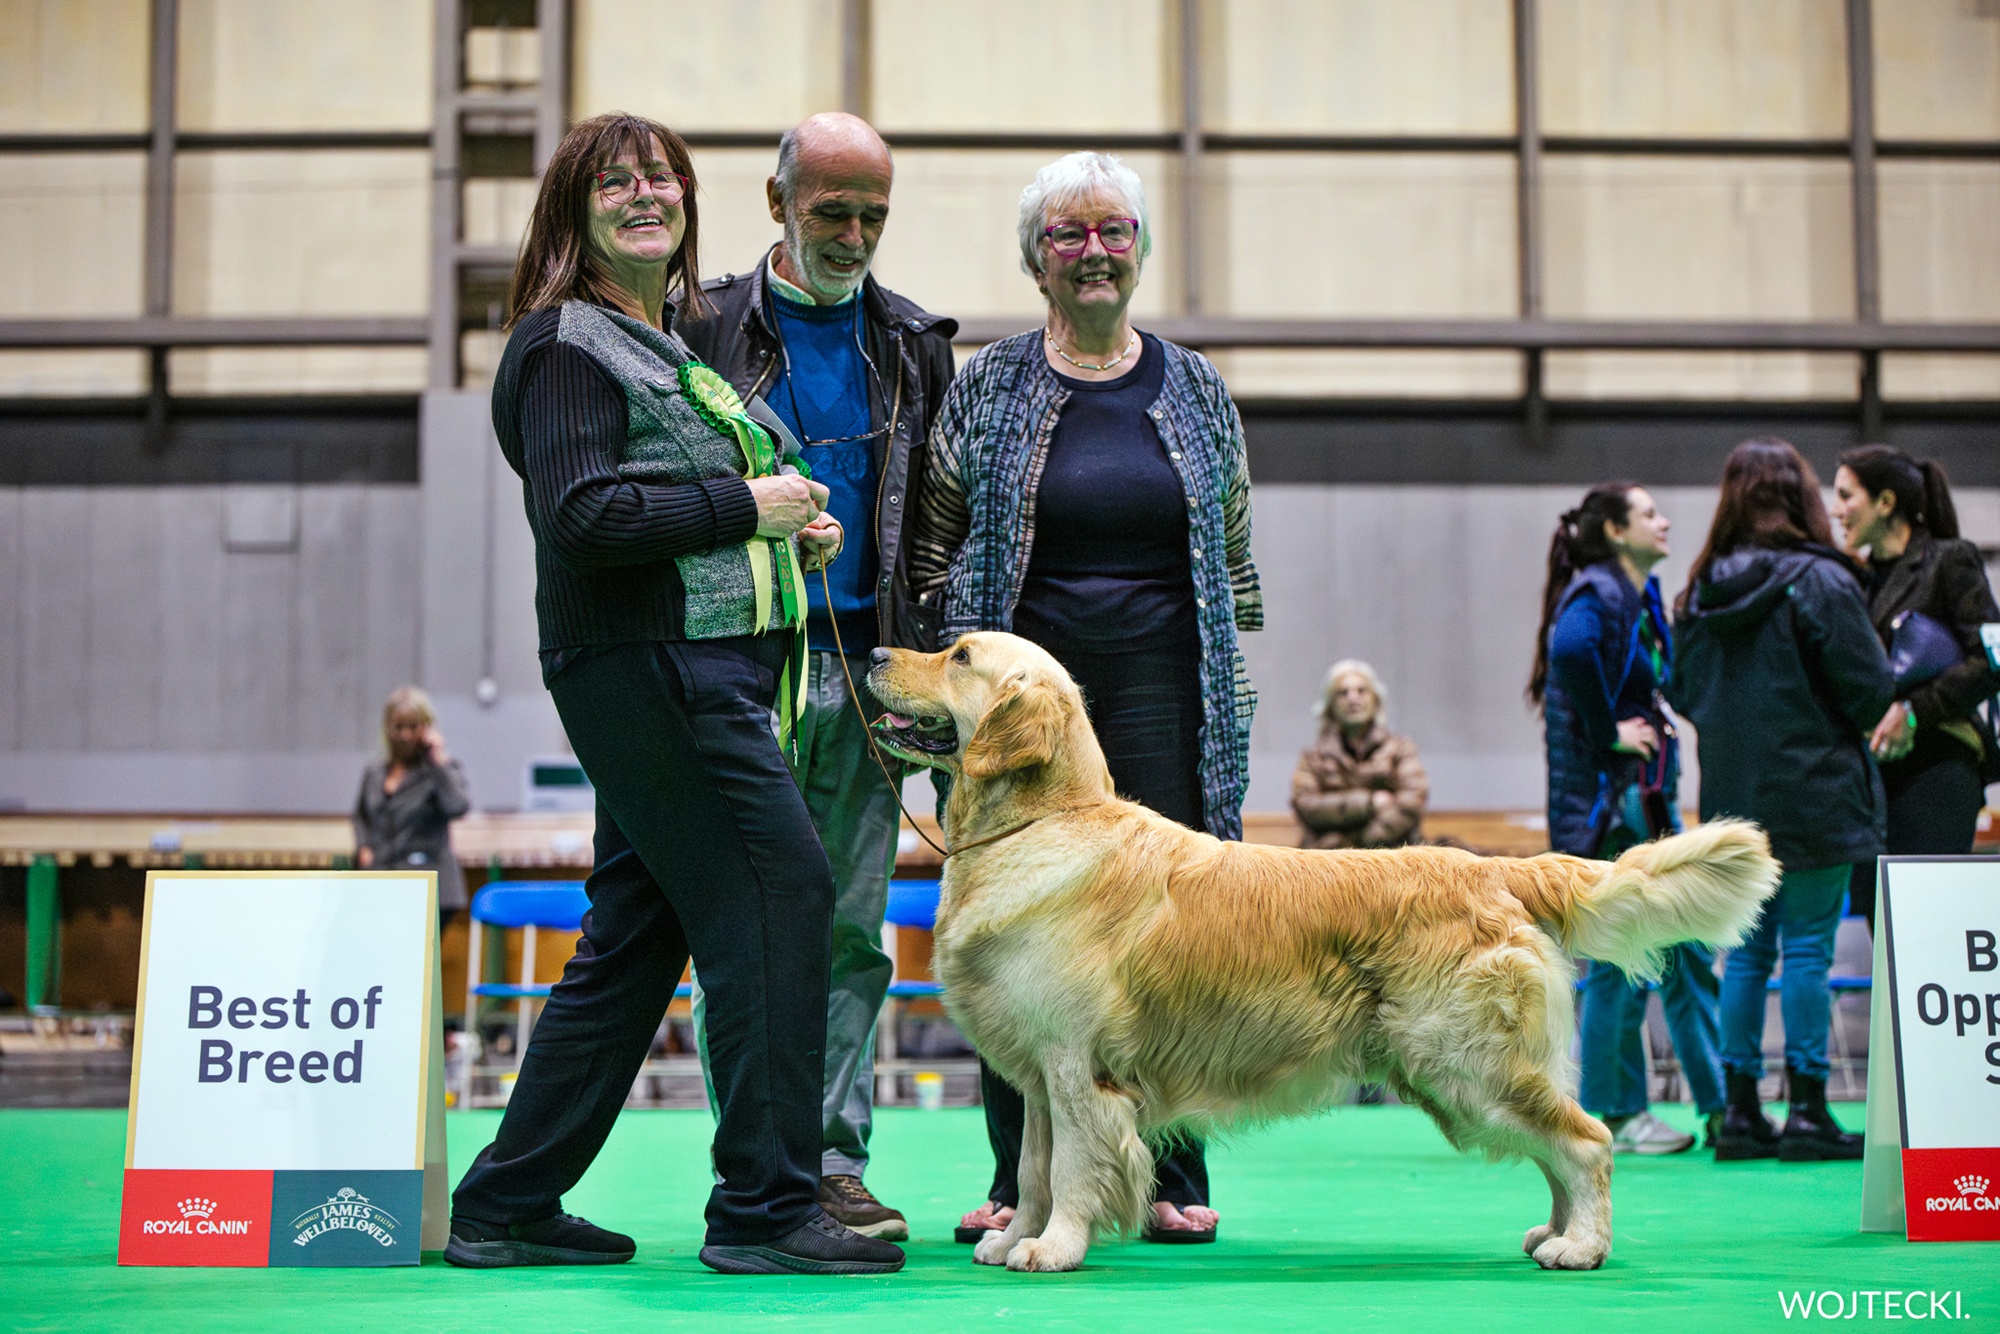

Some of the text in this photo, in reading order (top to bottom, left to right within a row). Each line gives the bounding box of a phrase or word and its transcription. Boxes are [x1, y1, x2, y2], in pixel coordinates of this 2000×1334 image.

[188, 985, 383, 1029] Best of
[198, 1039, 363, 1084] Breed
[322, 1204, 372, 1220] JAMES
[1925, 1197, 1972, 1212] ROYAL
[143, 1220, 193, 1235] ROYAL
[292, 1216, 394, 1247] WELLBELOVED
